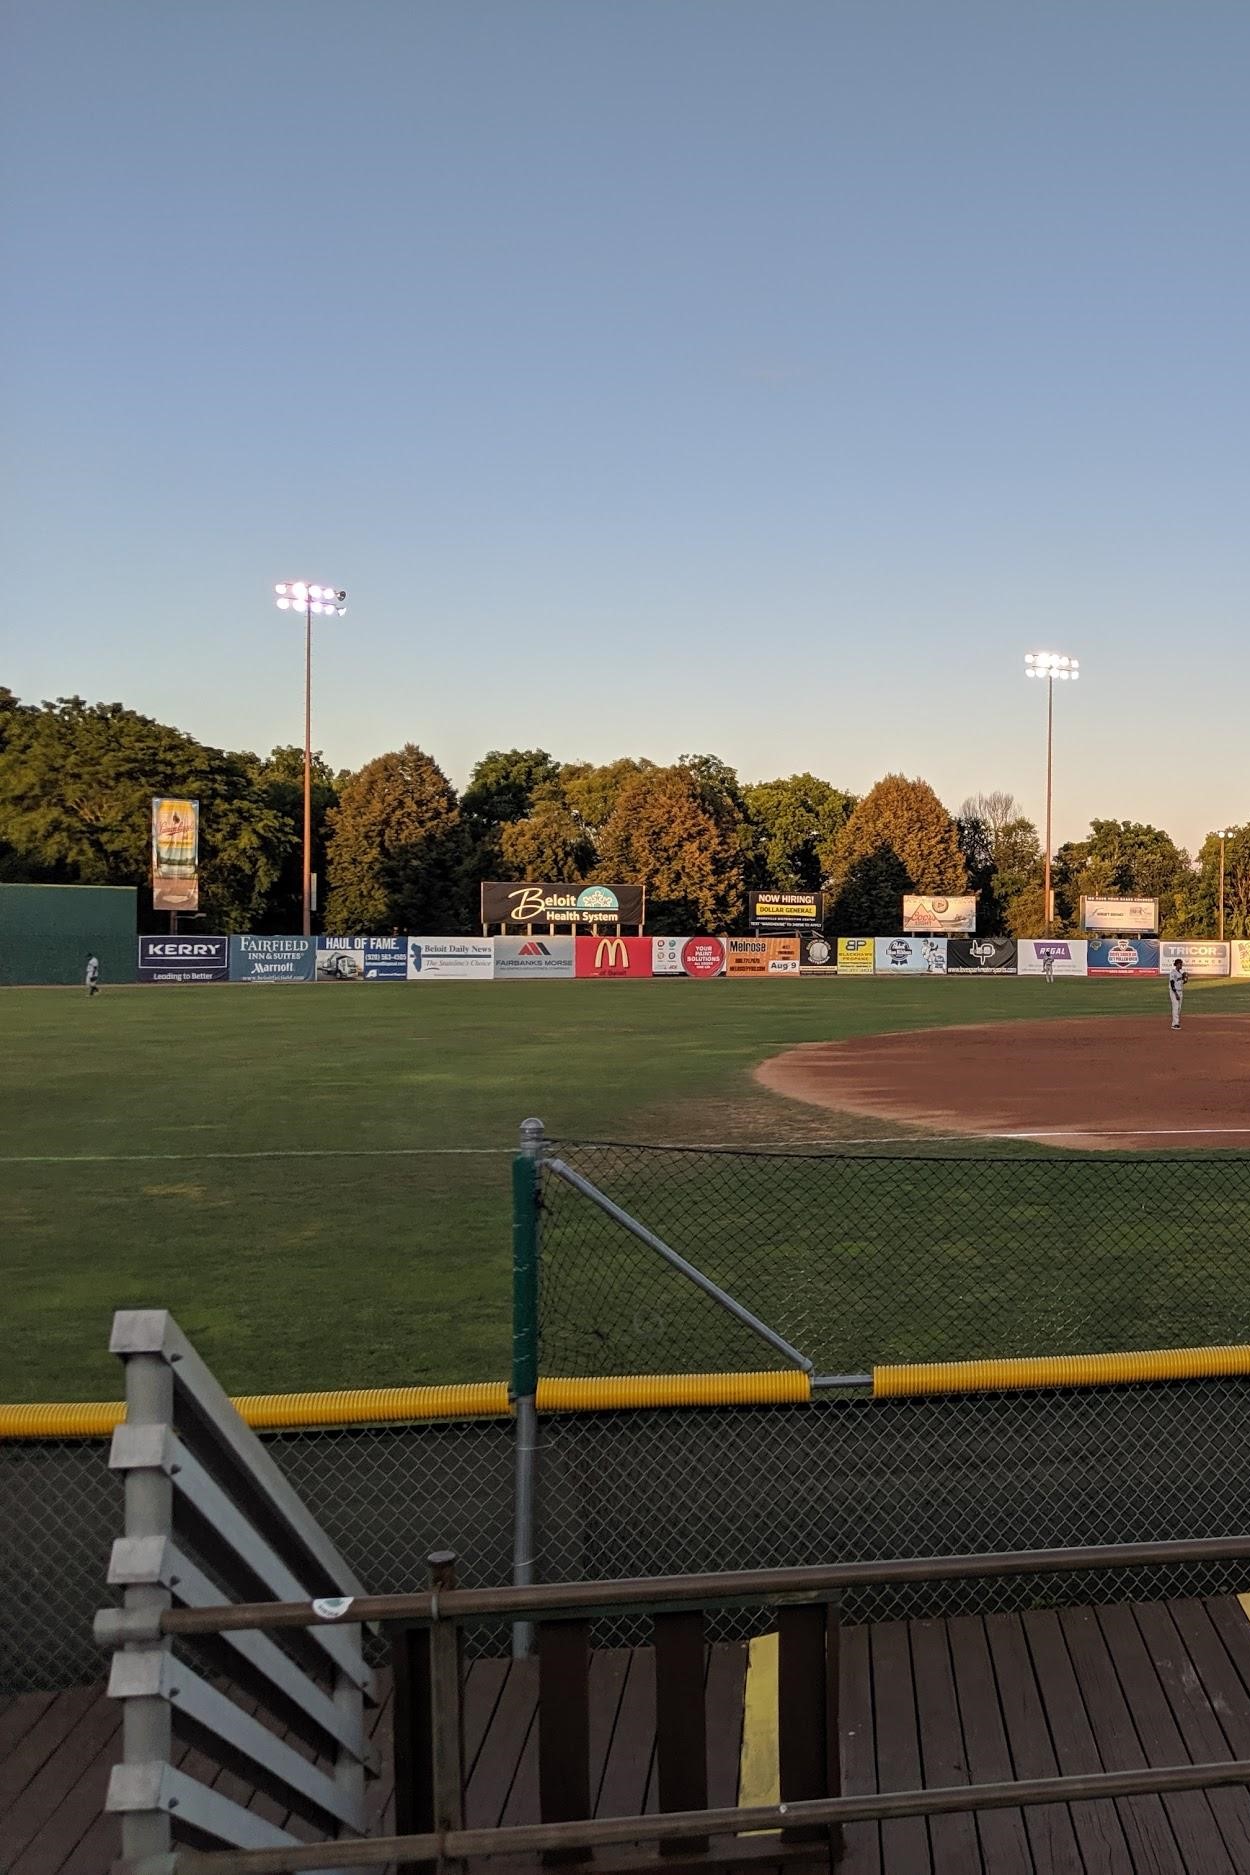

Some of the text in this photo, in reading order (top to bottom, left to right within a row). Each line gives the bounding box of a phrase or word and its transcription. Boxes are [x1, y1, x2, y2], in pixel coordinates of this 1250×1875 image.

[508, 887, 577, 920] Beloit
[758, 894, 814, 904] NOW HIRING!
[546, 911, 618, 923] Health System
[240, 936, 309, 952] FAIRFIELD
[326, 937, 350, 950] HAUL
[354, 938, 367, 950] OF
[449, 945, 469, 953] Daily
[730, 941, 766, 952] Melrose
[149, 943, 220, 956] KERRY
[1168, 947, 1217, 955] TRICOR
[251, 963, 294, 974] Marriott
[771, 962, 788, 970] Aug
[153, 973, 182, 981] Leading
